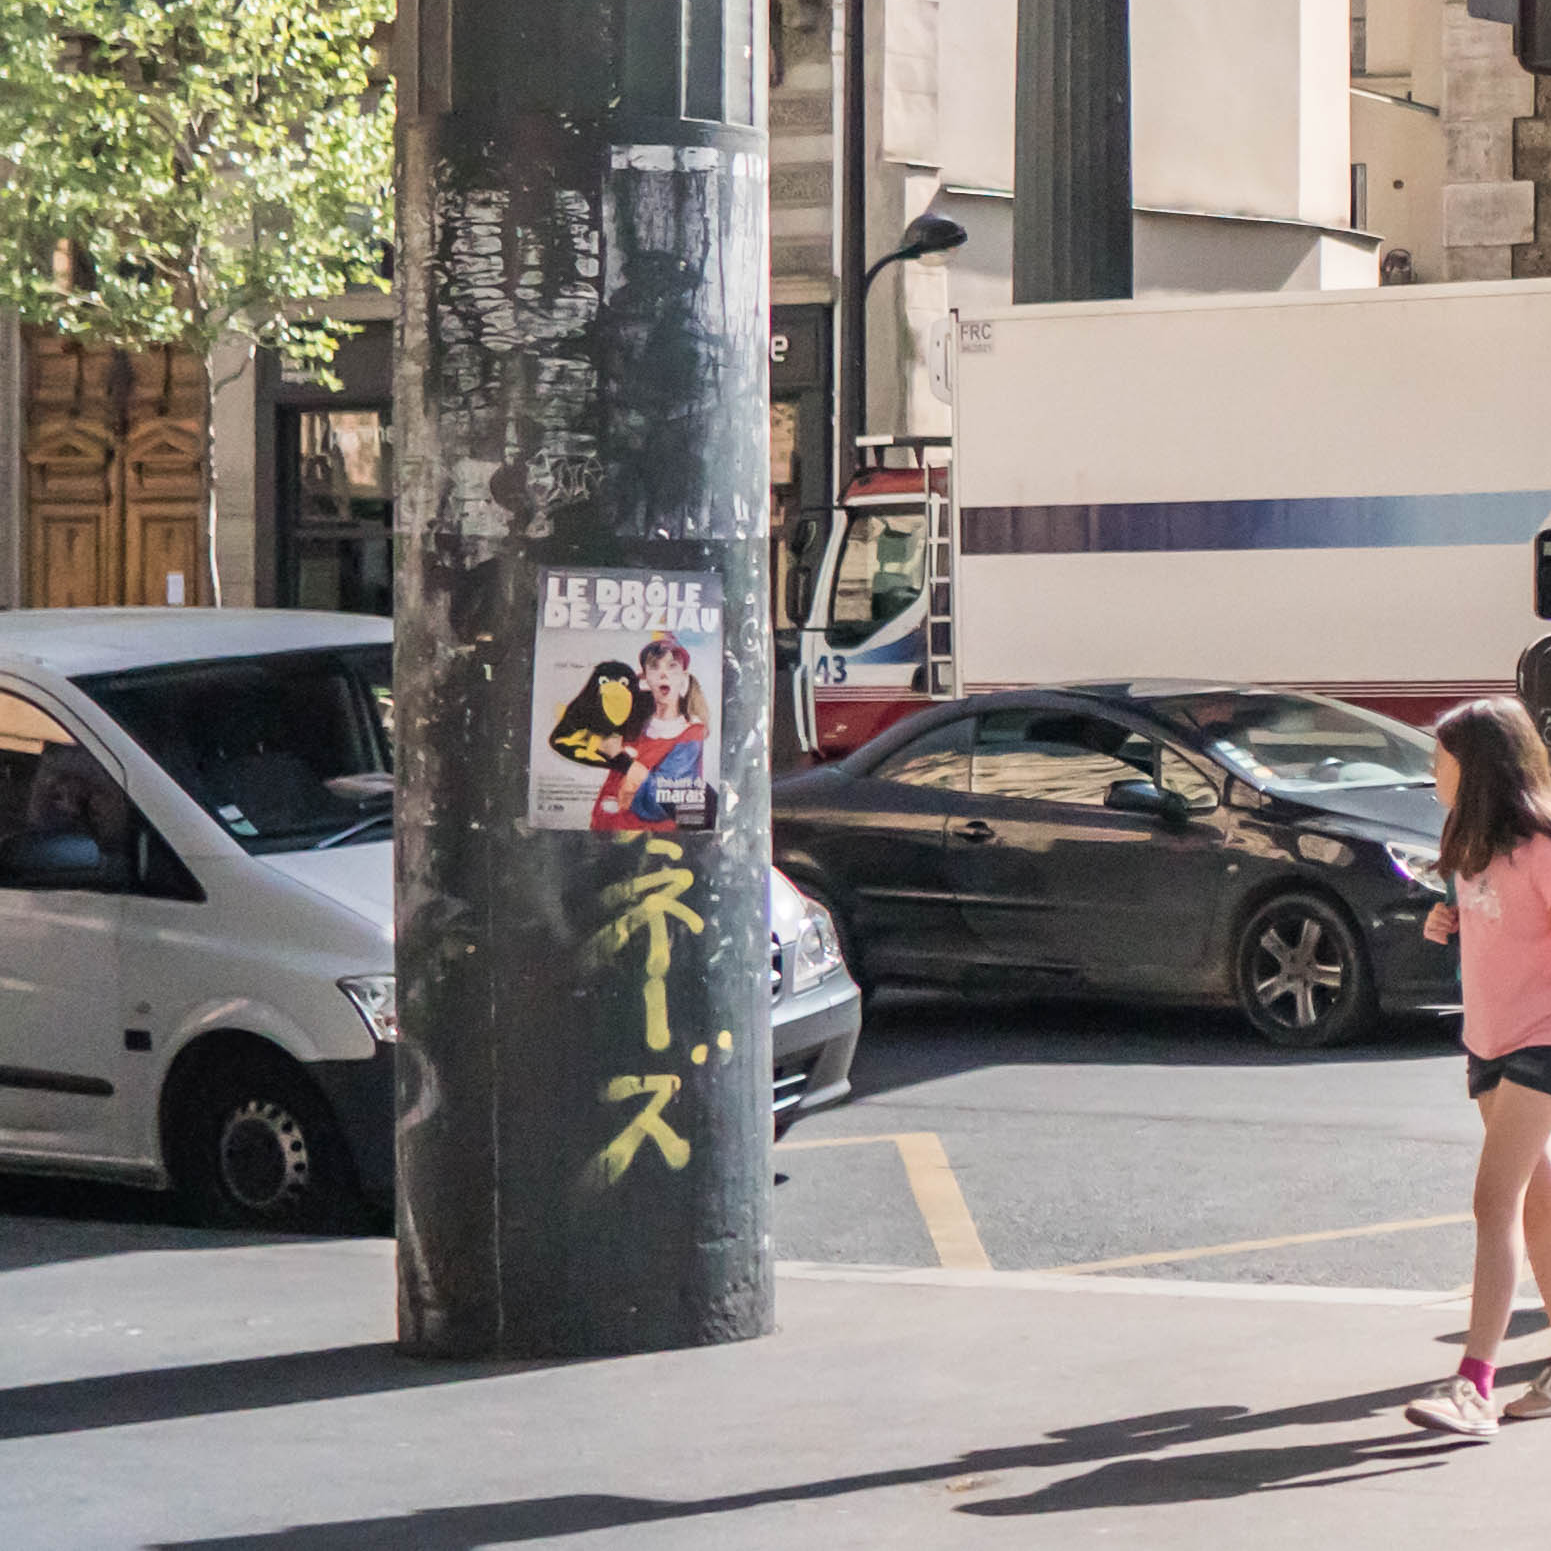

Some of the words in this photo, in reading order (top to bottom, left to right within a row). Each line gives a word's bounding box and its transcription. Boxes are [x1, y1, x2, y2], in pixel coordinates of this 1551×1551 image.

[960, 323, 992, 341] FRC
[546, 576, 589, 602] LE
[595, 575, 703, 608] DRÔLE
[543, 602, 592, 629] DE
[595, 602, 720, 632] ZOZIAU
[815, 655, 848, 684] 43
[655, 789, 706, 804] marais
[583, 831, 732, 1185] ネーズ
